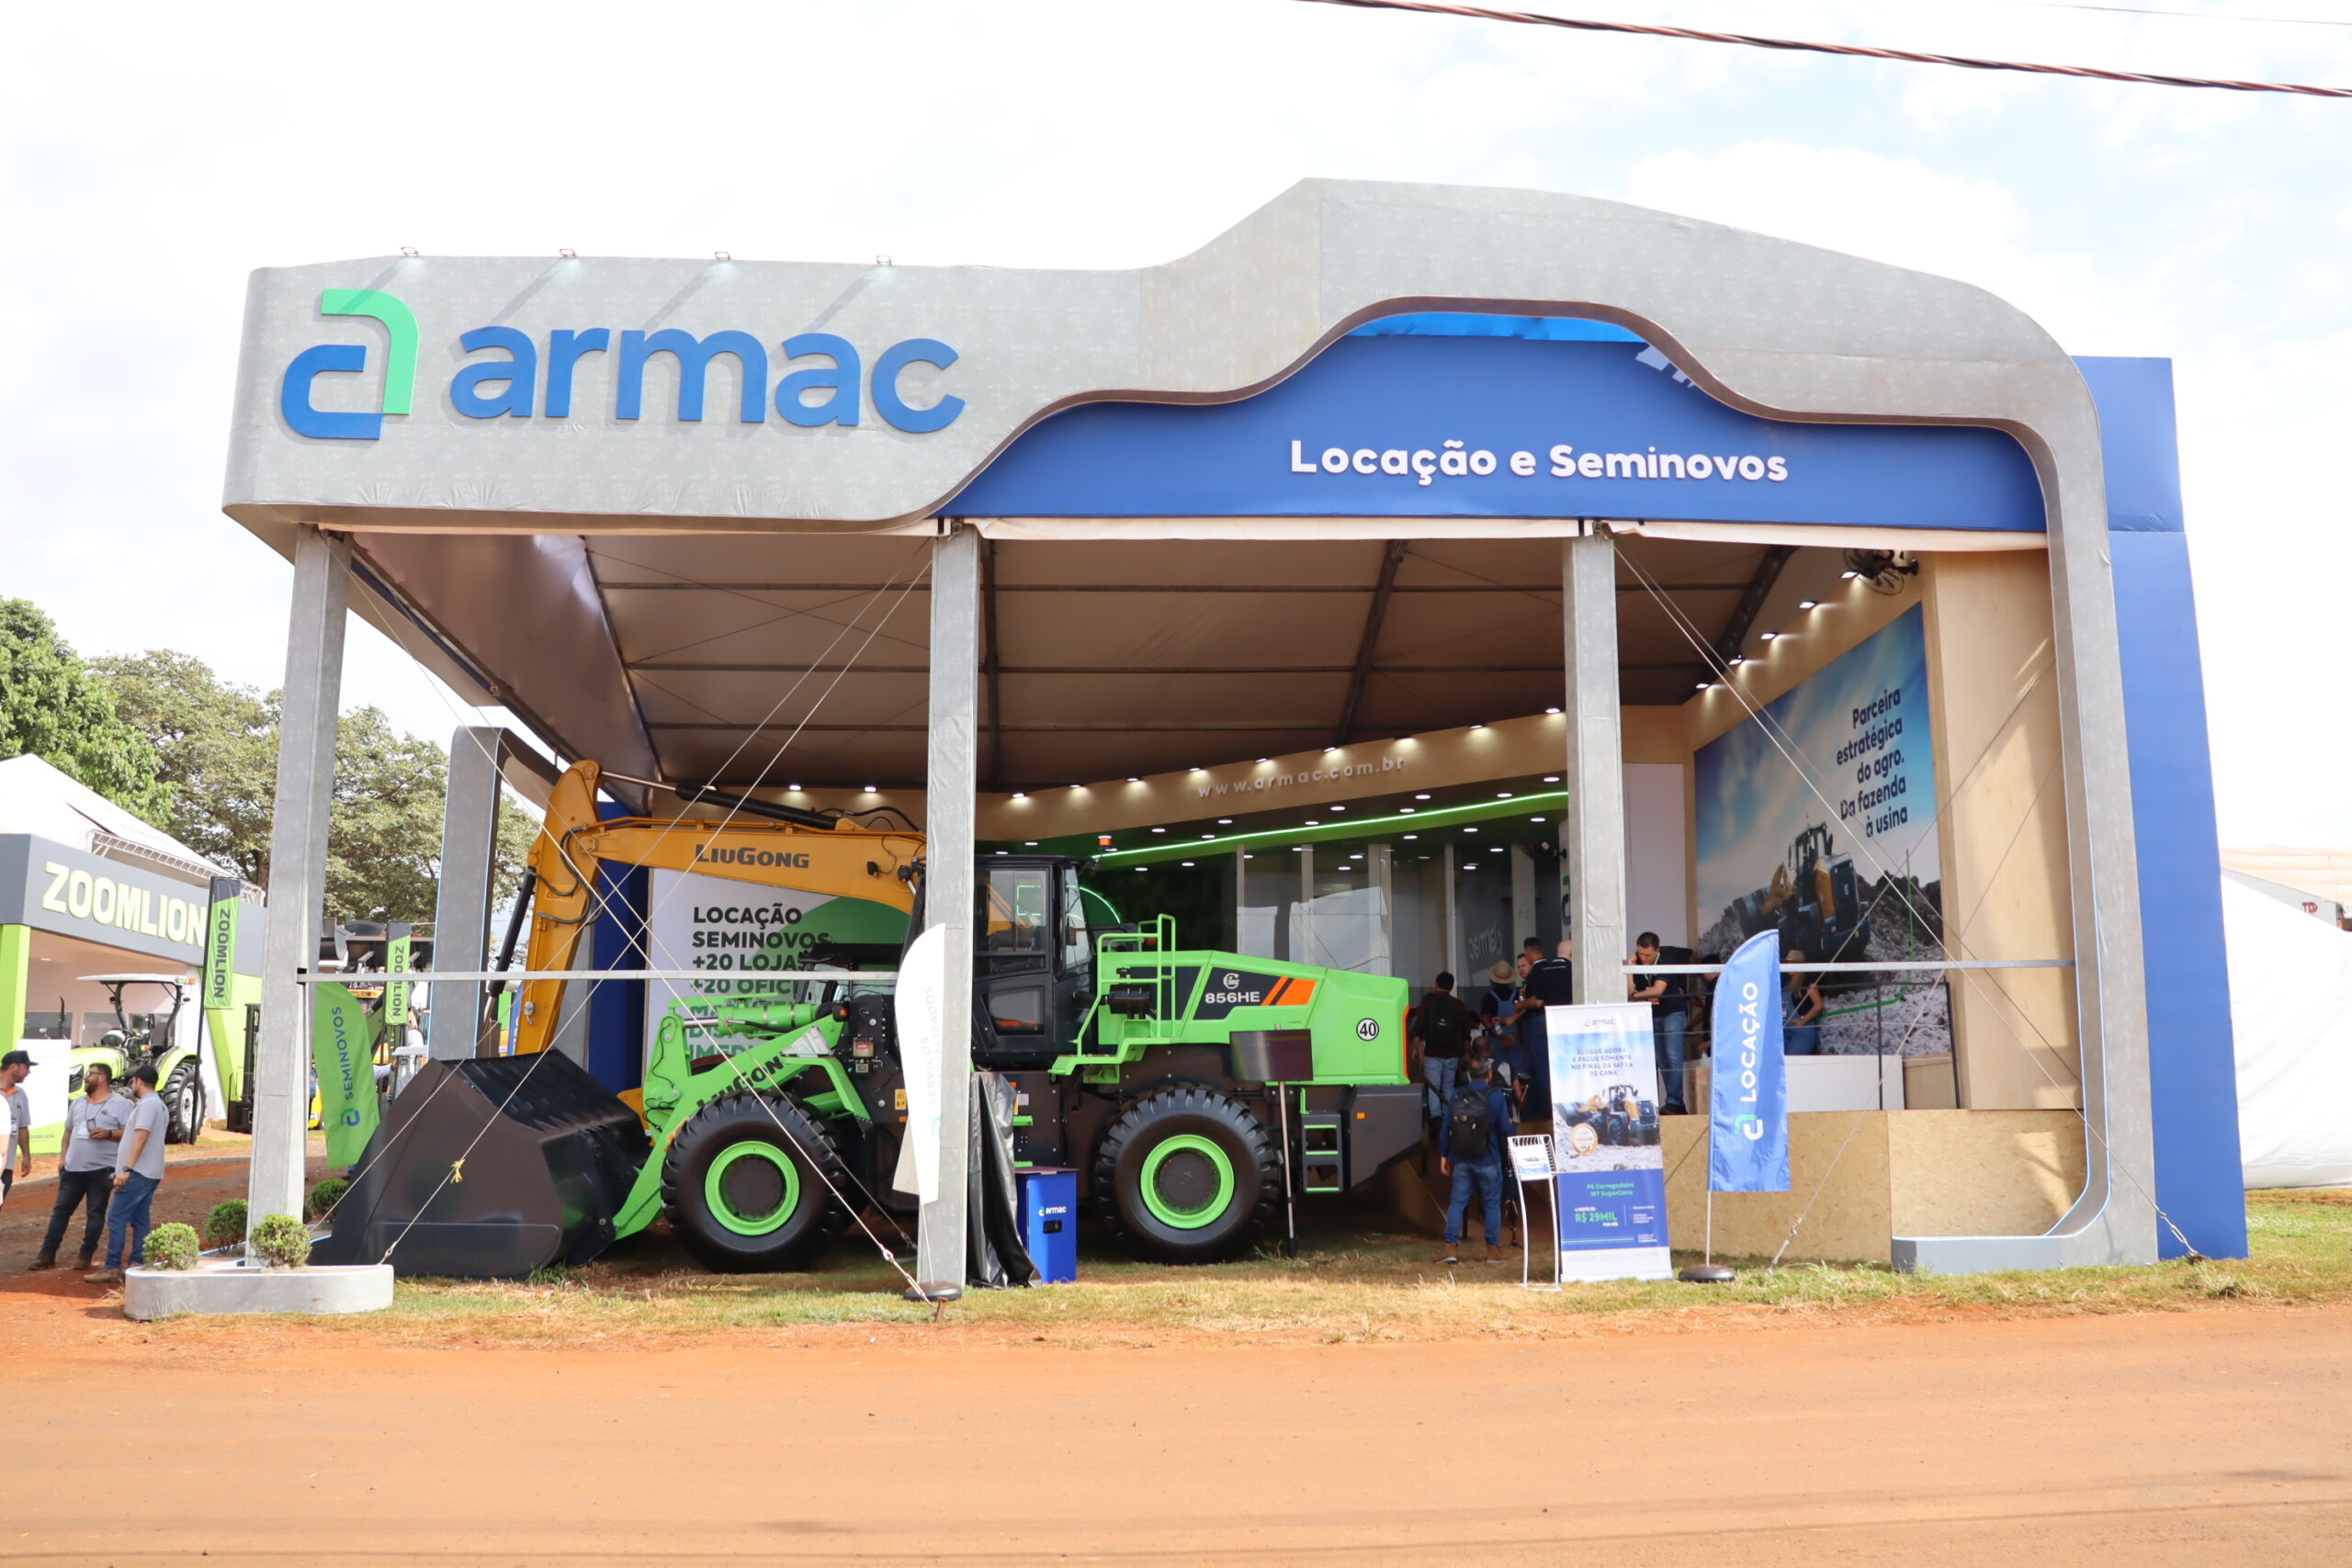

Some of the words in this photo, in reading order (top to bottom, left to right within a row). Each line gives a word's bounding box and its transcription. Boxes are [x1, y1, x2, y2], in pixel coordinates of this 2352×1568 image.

[449, 325, 967, 434] armac
[1291, 439, 1498, 487] Locação
[1510, 448, 1536, 476] e
[1549, 444, 1789, 481] Seminovos
[1852, 687, 1902, 729] Parceira
[1837, 716, 1903, 766] estratégica
[1198, 756, 1405, 799] www.armac.com.br
[1857, 761, 1872, 784] do
[1873, 748, 1905, 778] agro.
[1840, 799, 1856, 820] Da
[1858, 775, 1906, 813] fazenda
[1876, 806, 1908, 834] usina
[41, 861, 207, 949] ZOOMLION
[694, 903, 802, 930] LOCAÇÃO
[214, 908, 232, 999] ZOOMLION
[692, 931, 830, 949] SEMINOVOS
[392, 945, 404, 1017] ZOOLION
[693, 953, 733, 970] +20
[691, 979, 731, 993] +20
[1205, 991, 1261, 1003] 856HE
[1359, 1022, 1377, 1037] 40
[1591, 1018, 1615, 1026] armac
[332, 1007, 354, 1100] SEMINOVOS
[1739, 982, 1760, 1102] LOCAÇÃO
[1046, 1206, 1067, 1214] armac
[1575, 1212, 1588, 1224] R$
[1589, 1212, 1618, 1223] 29MIL
